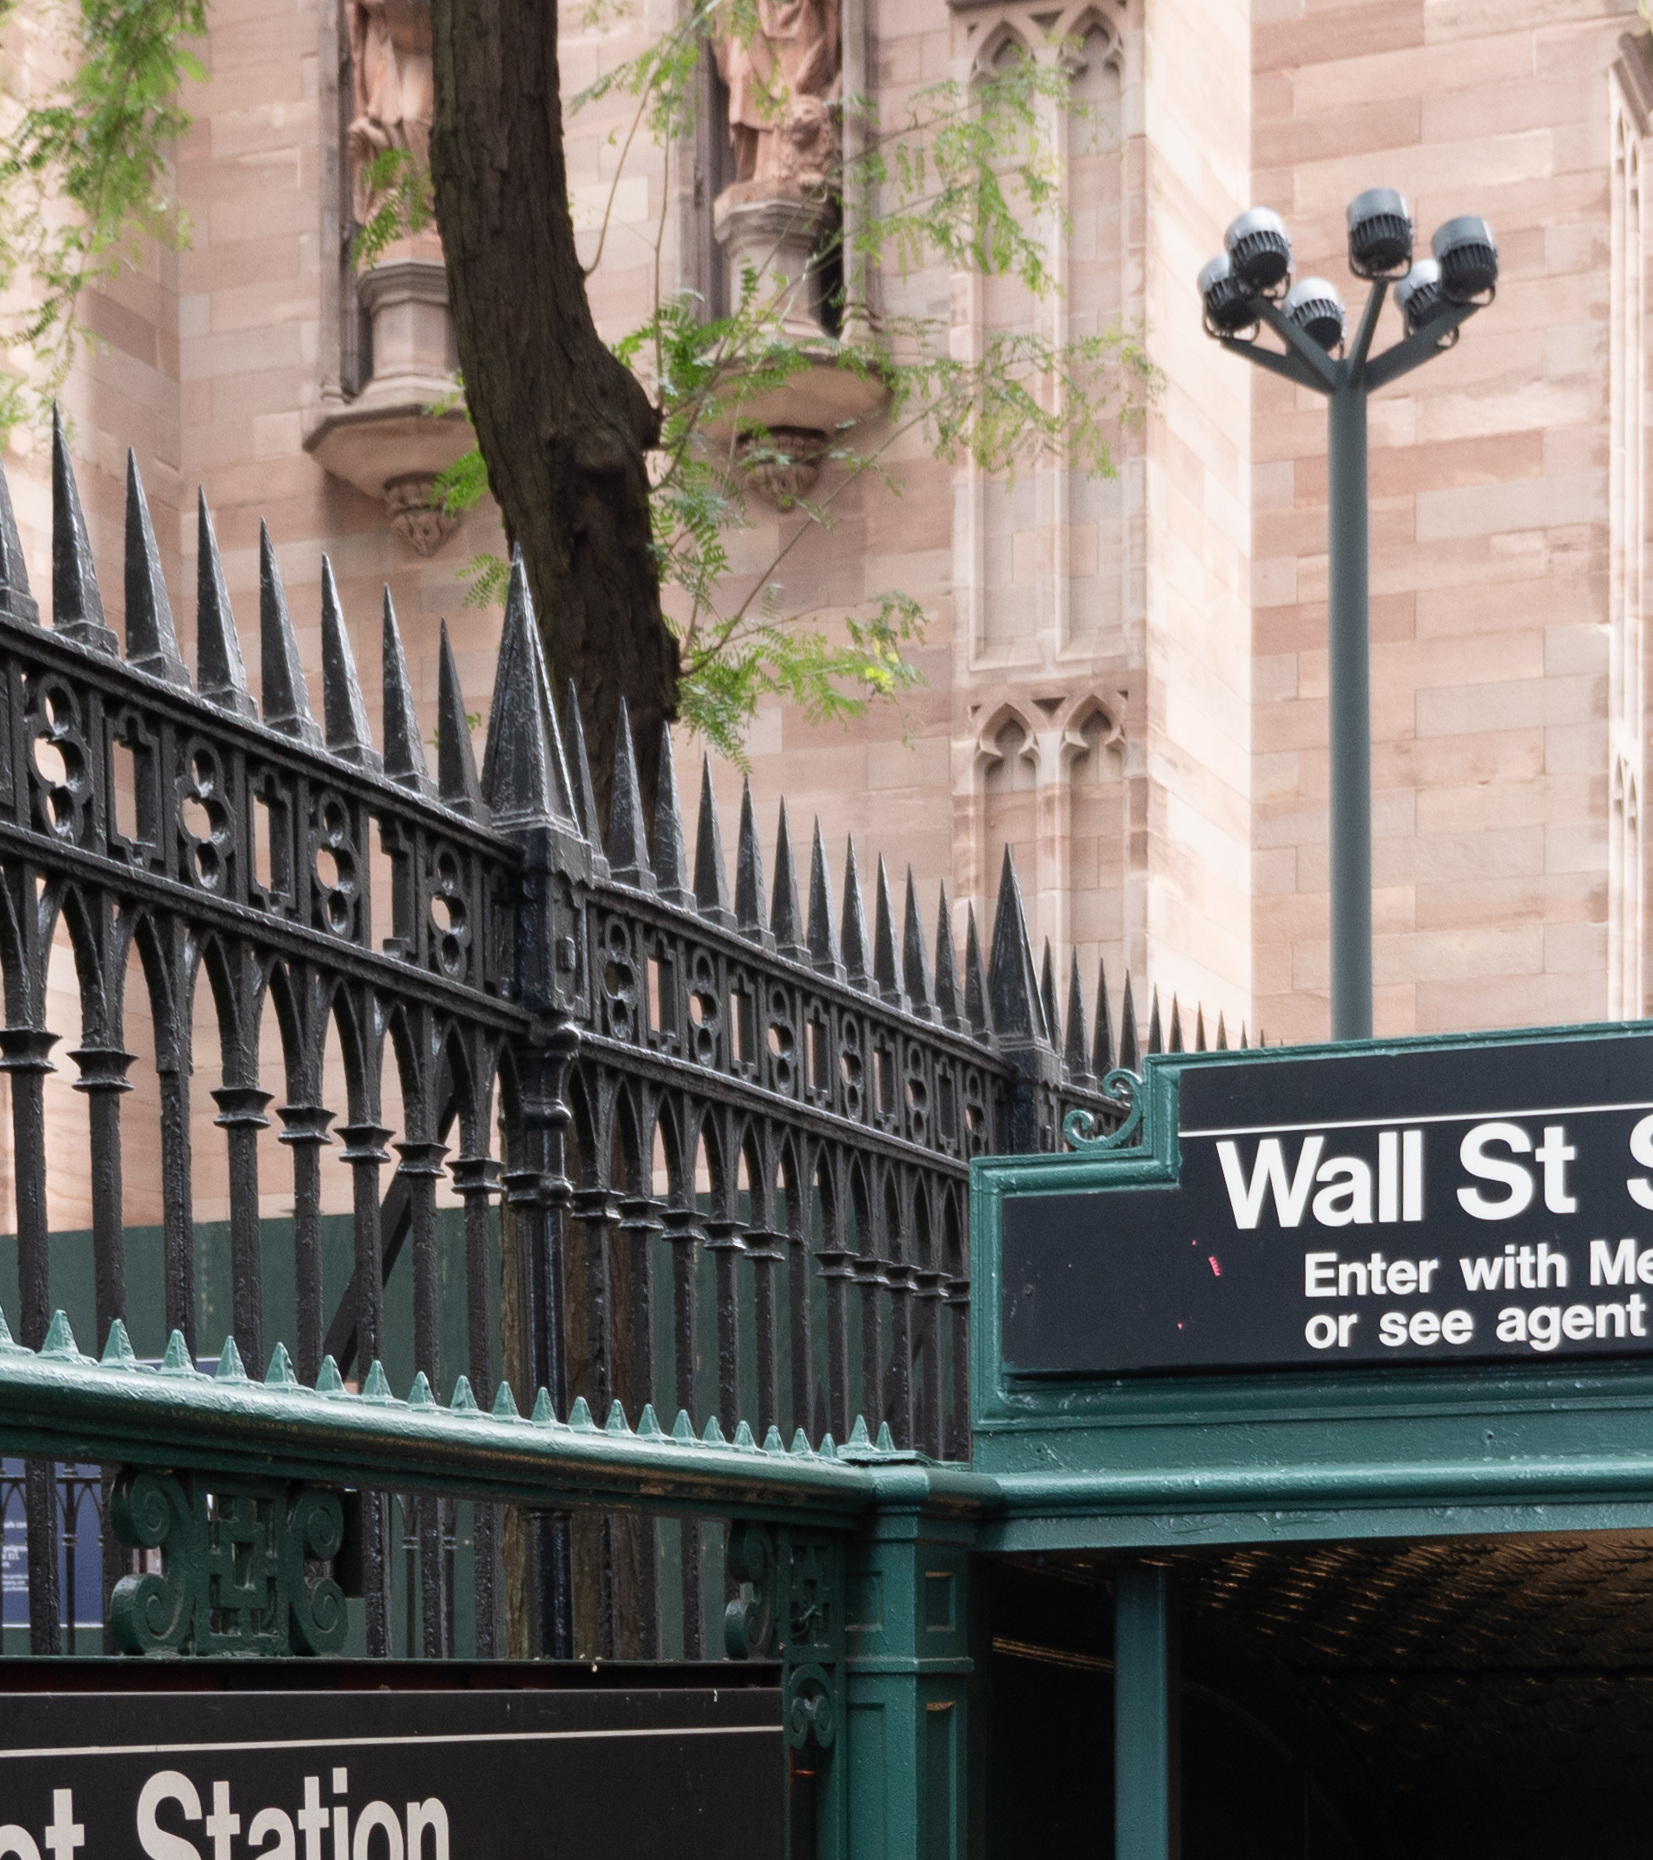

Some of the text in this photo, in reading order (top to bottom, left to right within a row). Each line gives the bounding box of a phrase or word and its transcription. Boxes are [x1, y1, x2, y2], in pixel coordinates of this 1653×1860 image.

[1216, 1130, 1423, 1229] Wall
[1457, 1122, 1576, 1220] St
[1305, 1253, 1438, 1297] Enter
[1460, 1243, 1567, 1290] with
[1305, 1314, 1357, 1348] or
[1379, 1310, 1473, 1346] see
[1497, 1294, 1646, 1351] agent
